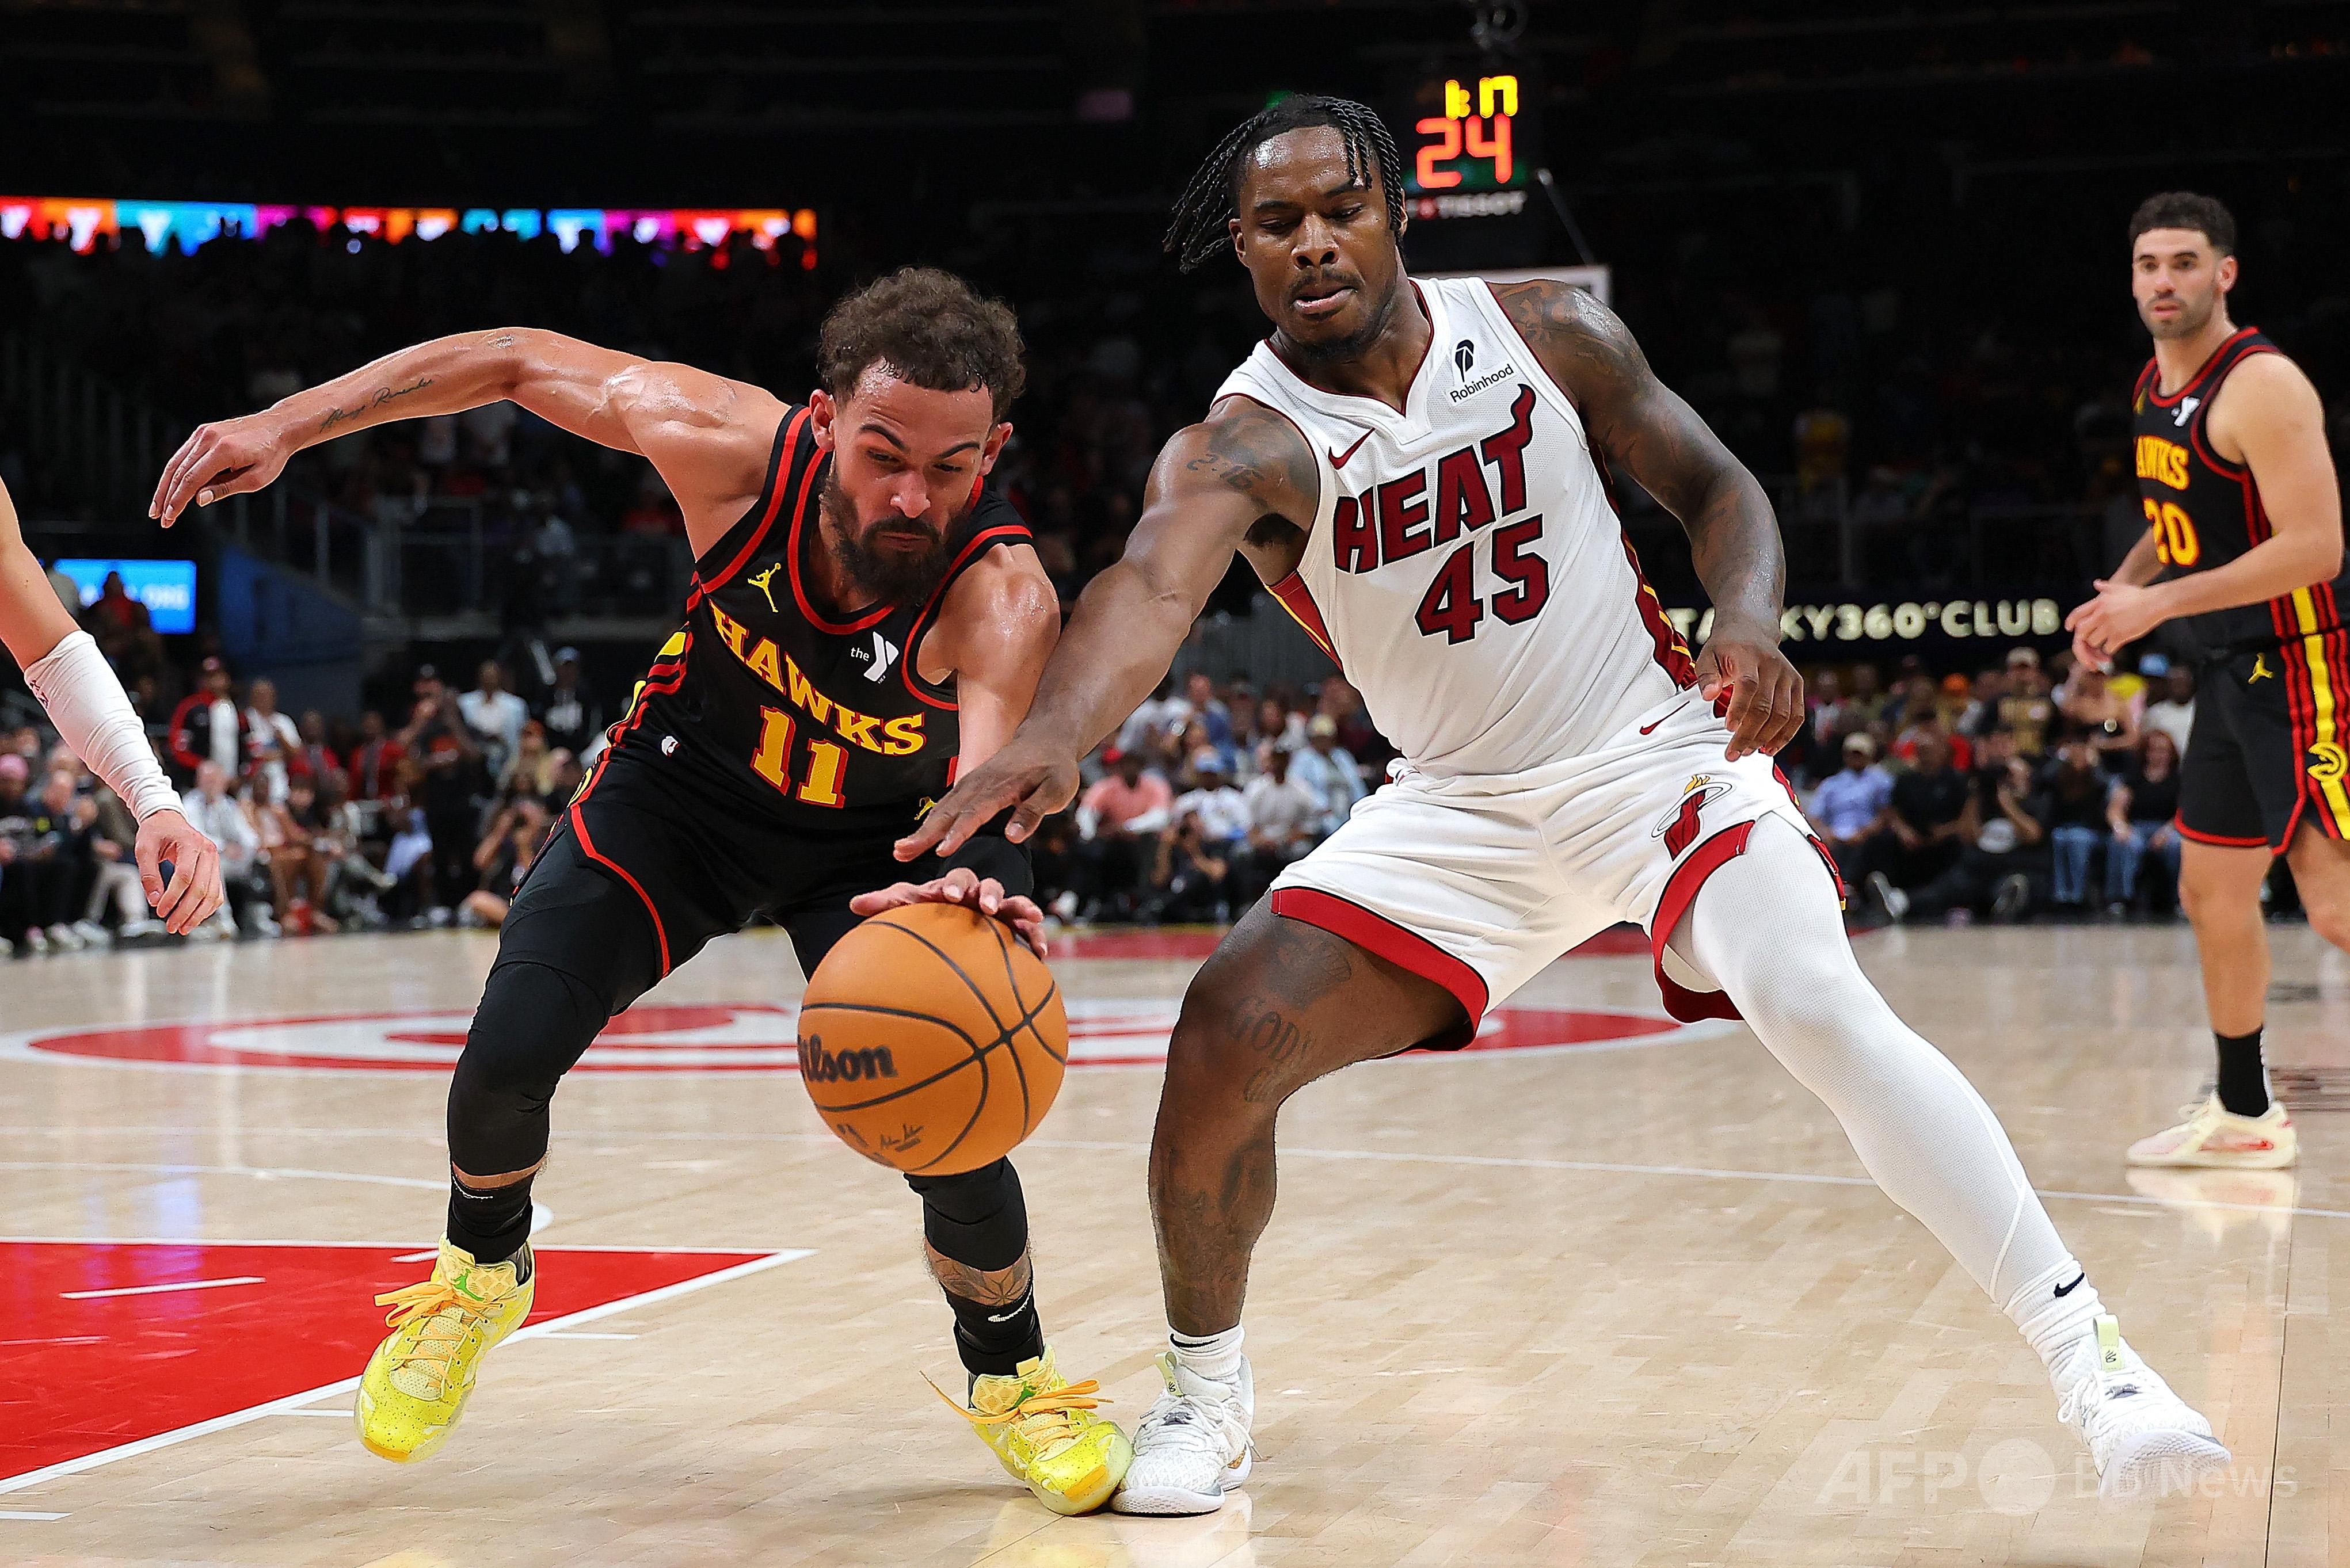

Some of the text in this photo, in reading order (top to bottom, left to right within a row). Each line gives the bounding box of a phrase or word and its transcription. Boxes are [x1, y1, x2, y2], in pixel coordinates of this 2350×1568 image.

[1416, 114, 1513, 188] 24
[1450, 363, 1514, 403] Robinhood
[1334, 383, 1536, 574] HEAT
[2143, 497, 2200, 566] 20
[1415, 514, 1549, 644] 45
[709, 598, 925, 756] HAWKS
[851, 647, 870, 662] the
[751, 705, 849, 808] 11
